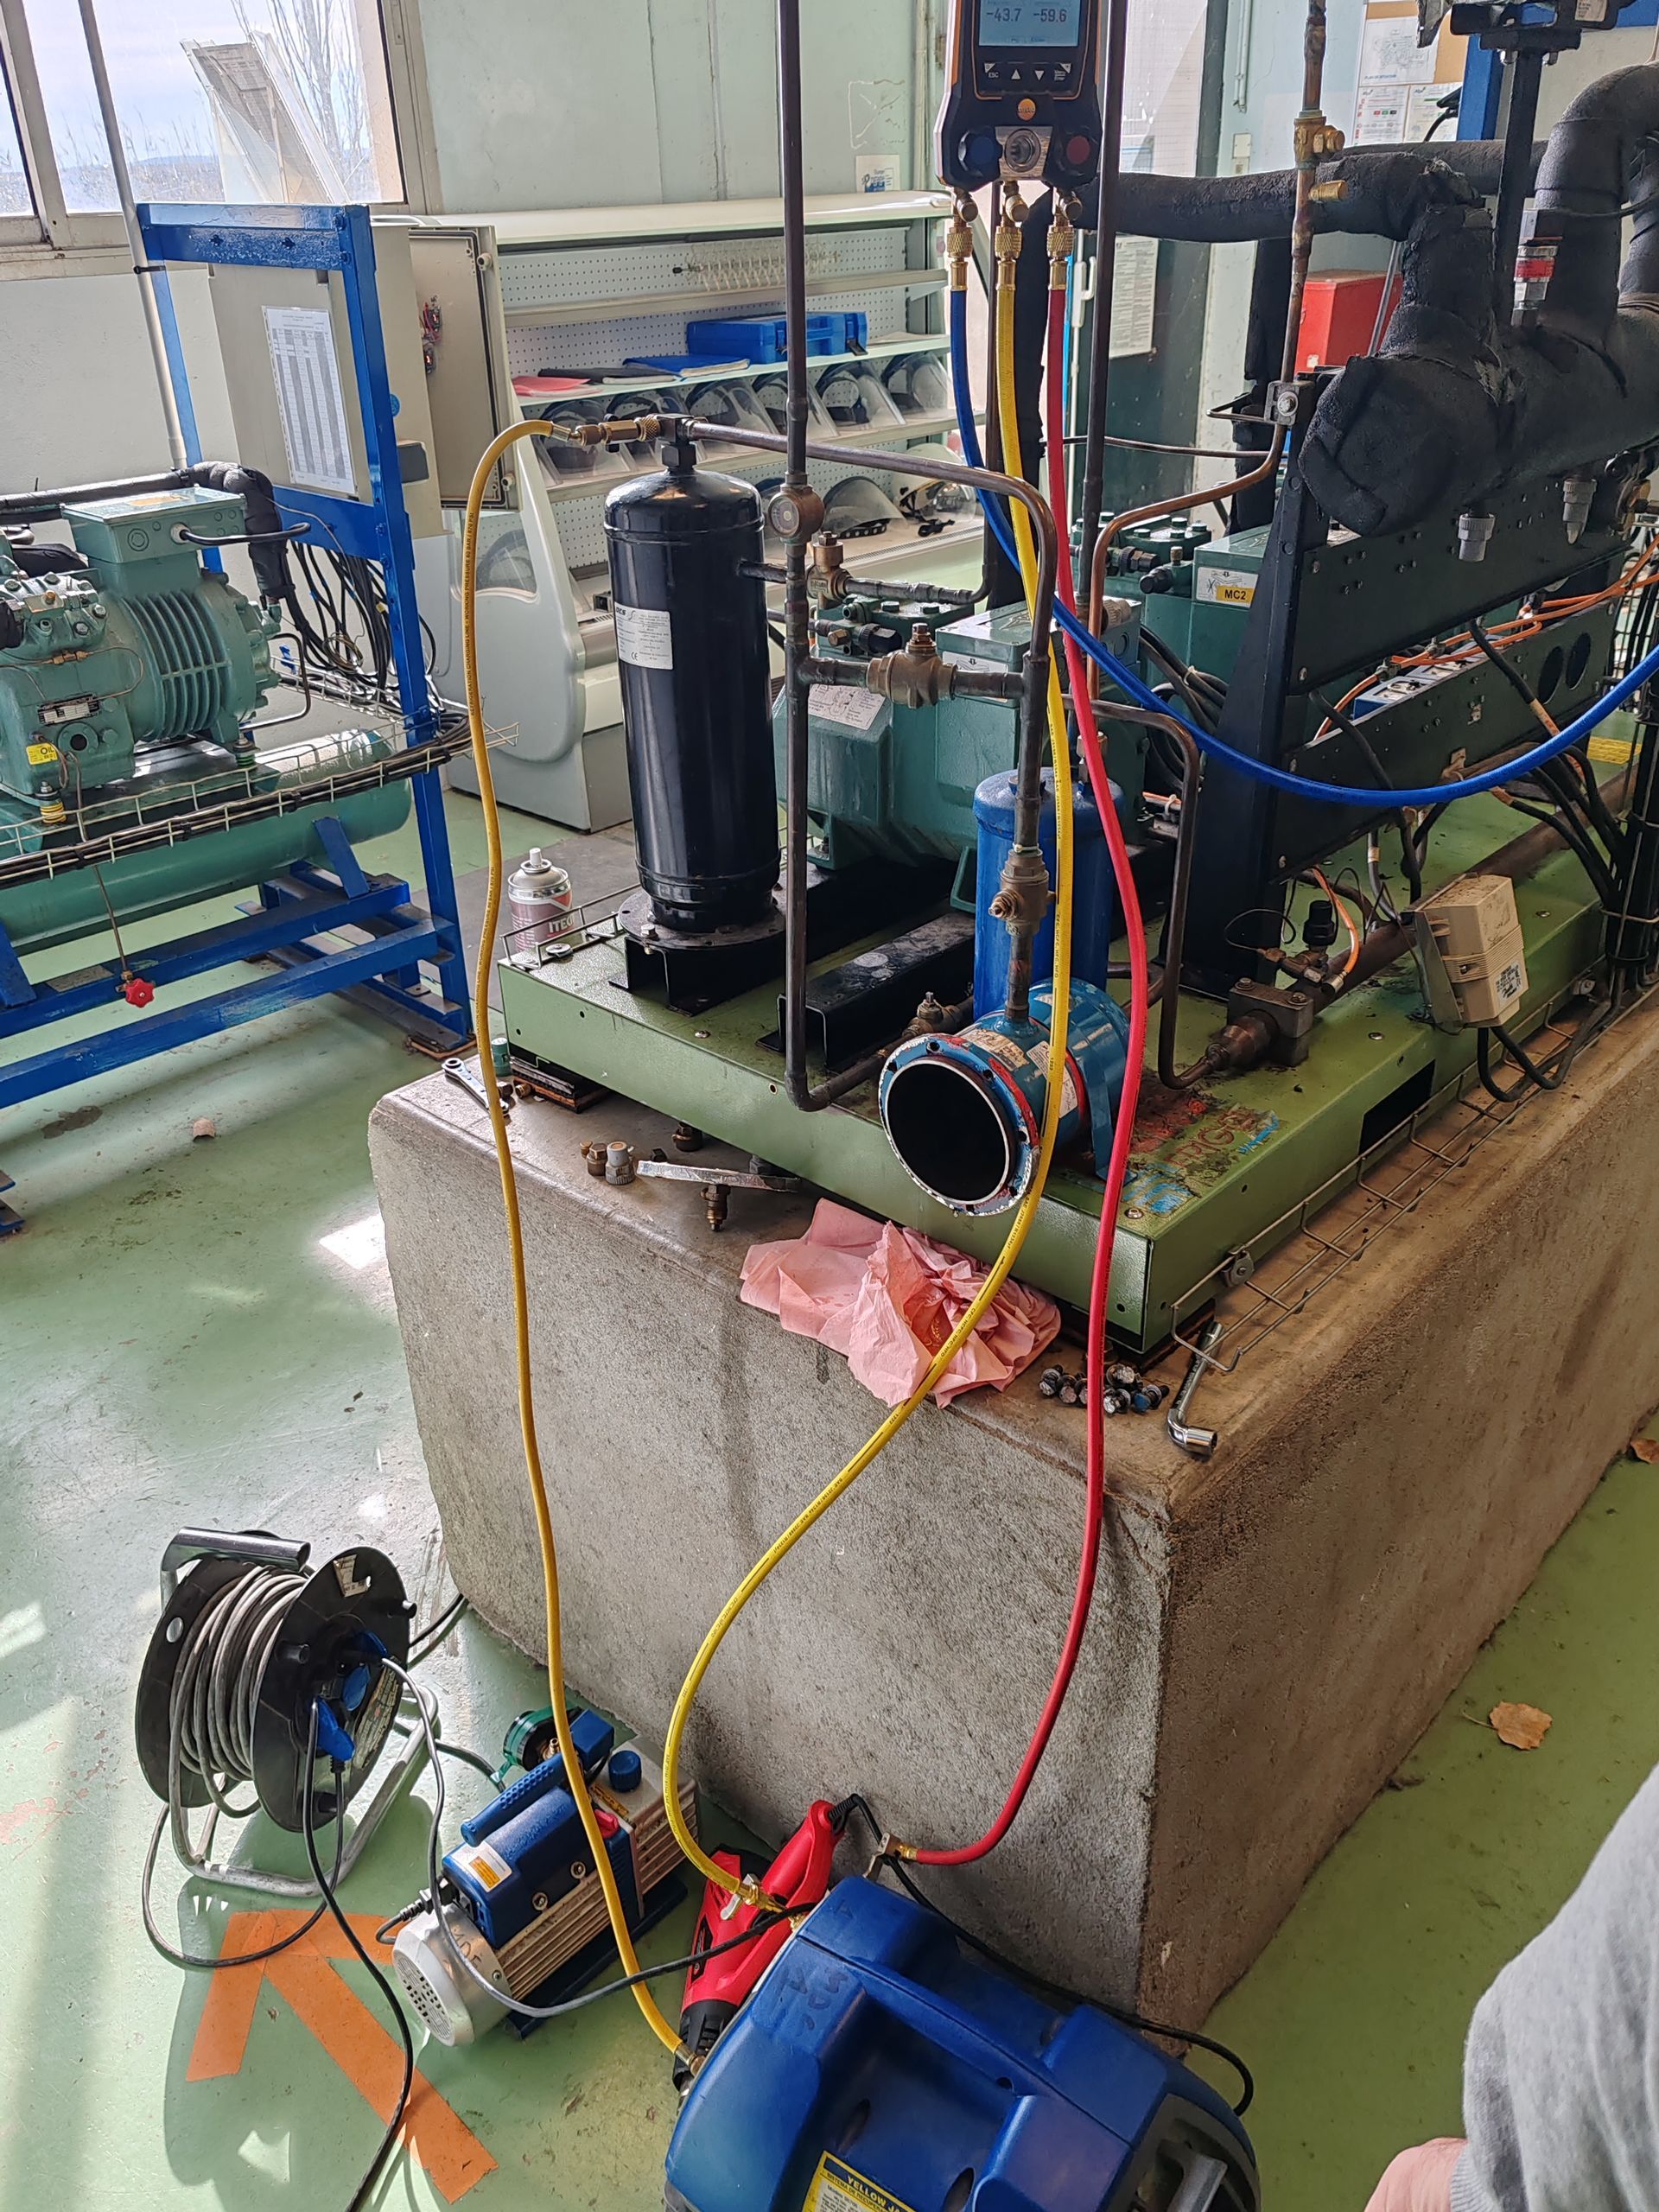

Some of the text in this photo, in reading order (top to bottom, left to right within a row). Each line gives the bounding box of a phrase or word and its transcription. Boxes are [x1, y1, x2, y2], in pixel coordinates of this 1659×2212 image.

[987, 8, 1021, 22] -43.7
[1224, 589, 1247, 601] MC2
[832, 1476, 843, 1488] SAE
[798, 1513, 809, 1524] SAE
[848, 2174, 887, 2207] YELLOW
